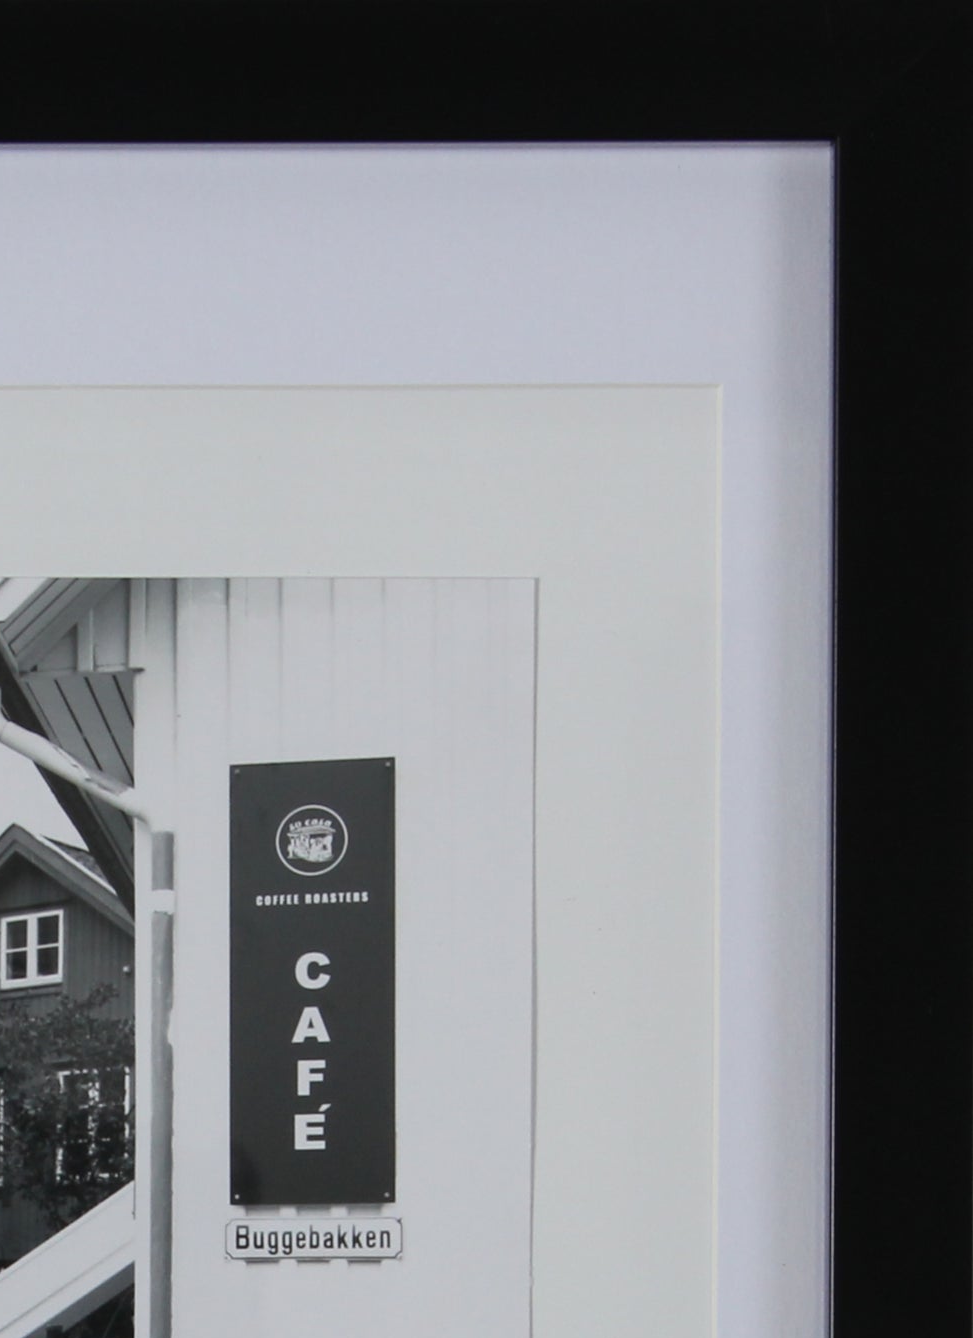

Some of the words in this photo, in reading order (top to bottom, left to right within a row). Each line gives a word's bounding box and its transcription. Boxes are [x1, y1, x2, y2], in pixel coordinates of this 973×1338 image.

[255, 894, 300, 906] COFFEE
[305, 891, 369, 904] ROASTERS
[292, 952, 331, 1150] CAFÉ
[235, 1224, 391, 1255] Buggebakken
